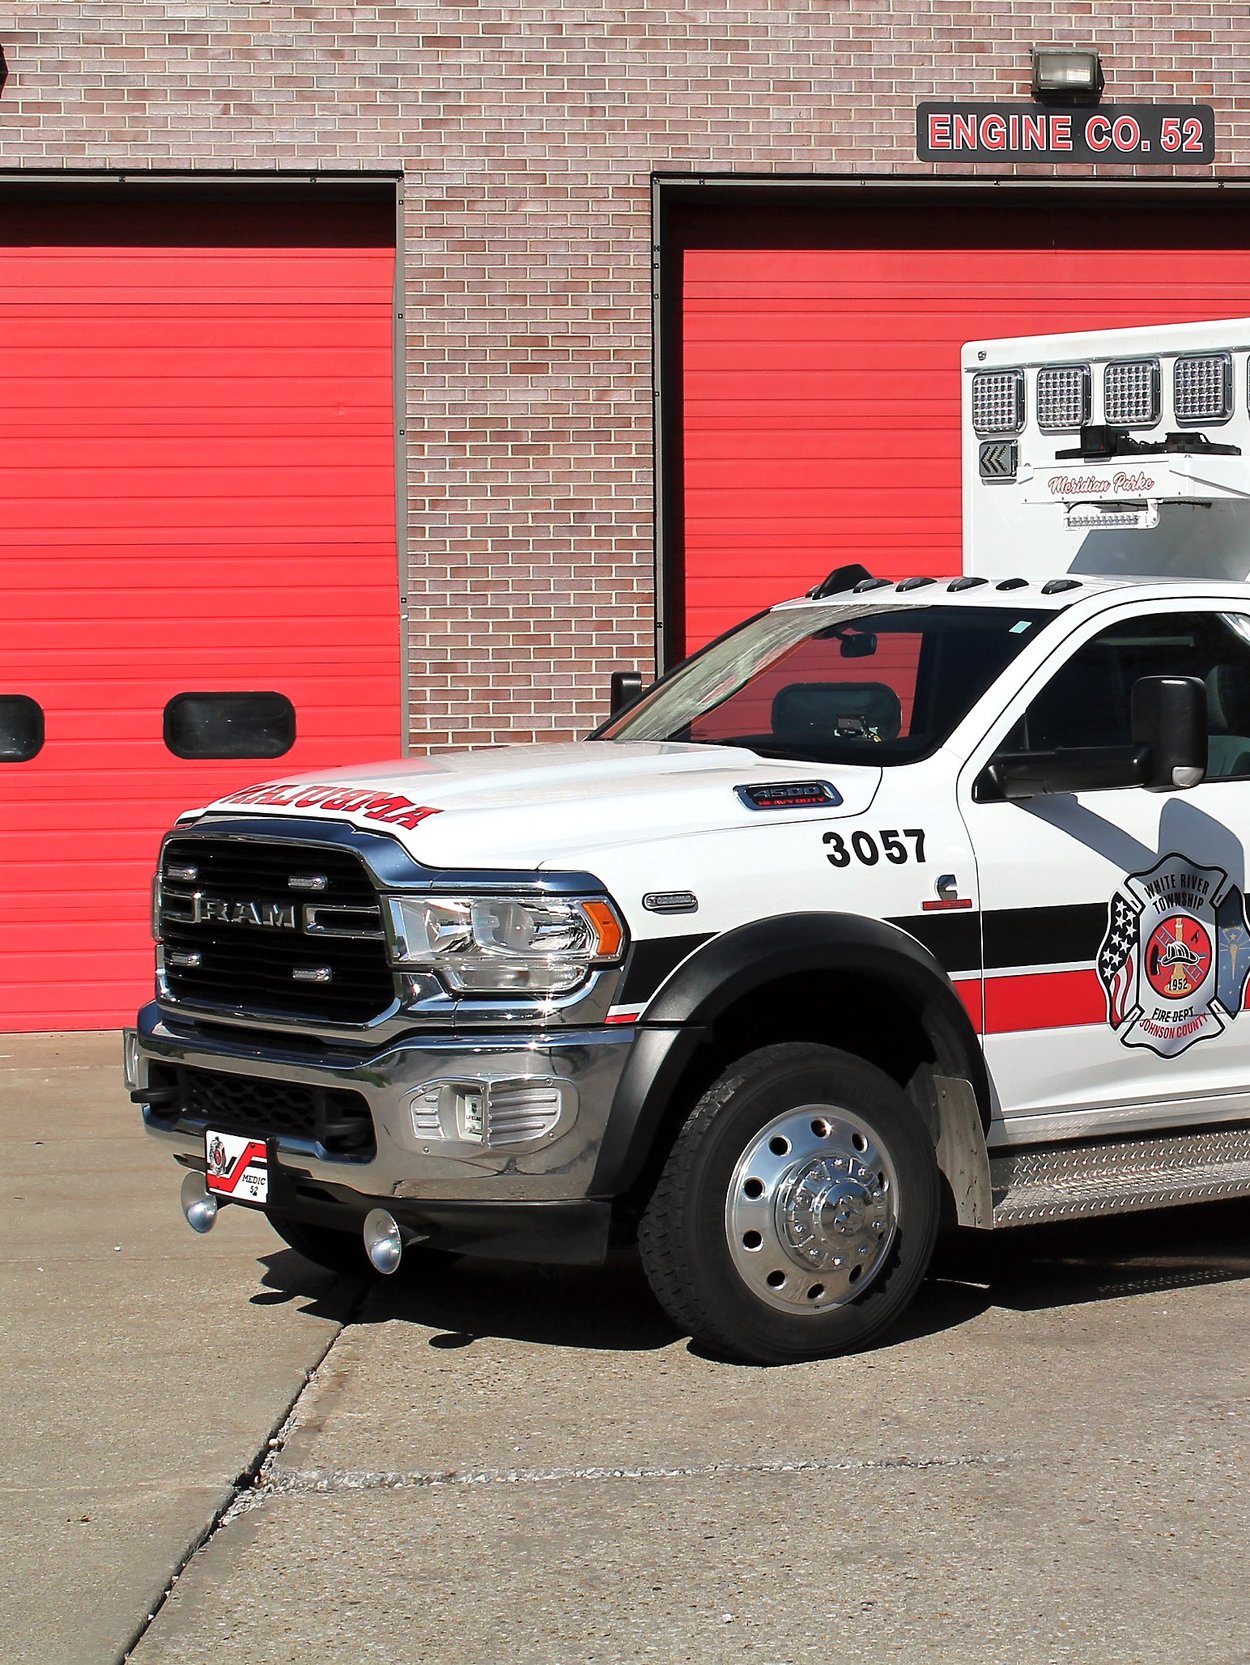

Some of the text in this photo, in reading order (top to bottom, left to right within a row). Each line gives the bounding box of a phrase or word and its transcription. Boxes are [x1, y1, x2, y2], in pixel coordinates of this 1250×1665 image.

[928, 114, 1203, 153] ENGINE CO. 52
[1048, 471, 1155, 495] Meridian Parke
[753, 786, 820, 799] 4500
[822, 829, 926, 868] 3057
[1144, 873, 1210, 899] WHITE RIVER
[201, 900, 296, 929] RAM
[1152, 892, 1204, 914] TOWNSHIP
[1168, 978, 1188, 991] 1952
[1139, 1012, 1209, 1039] JOHNSON COUNTY
[1152, 1005, 1194, 1023] FIRE DEPT
[242, 1174, 266, 1185] MEDIC
